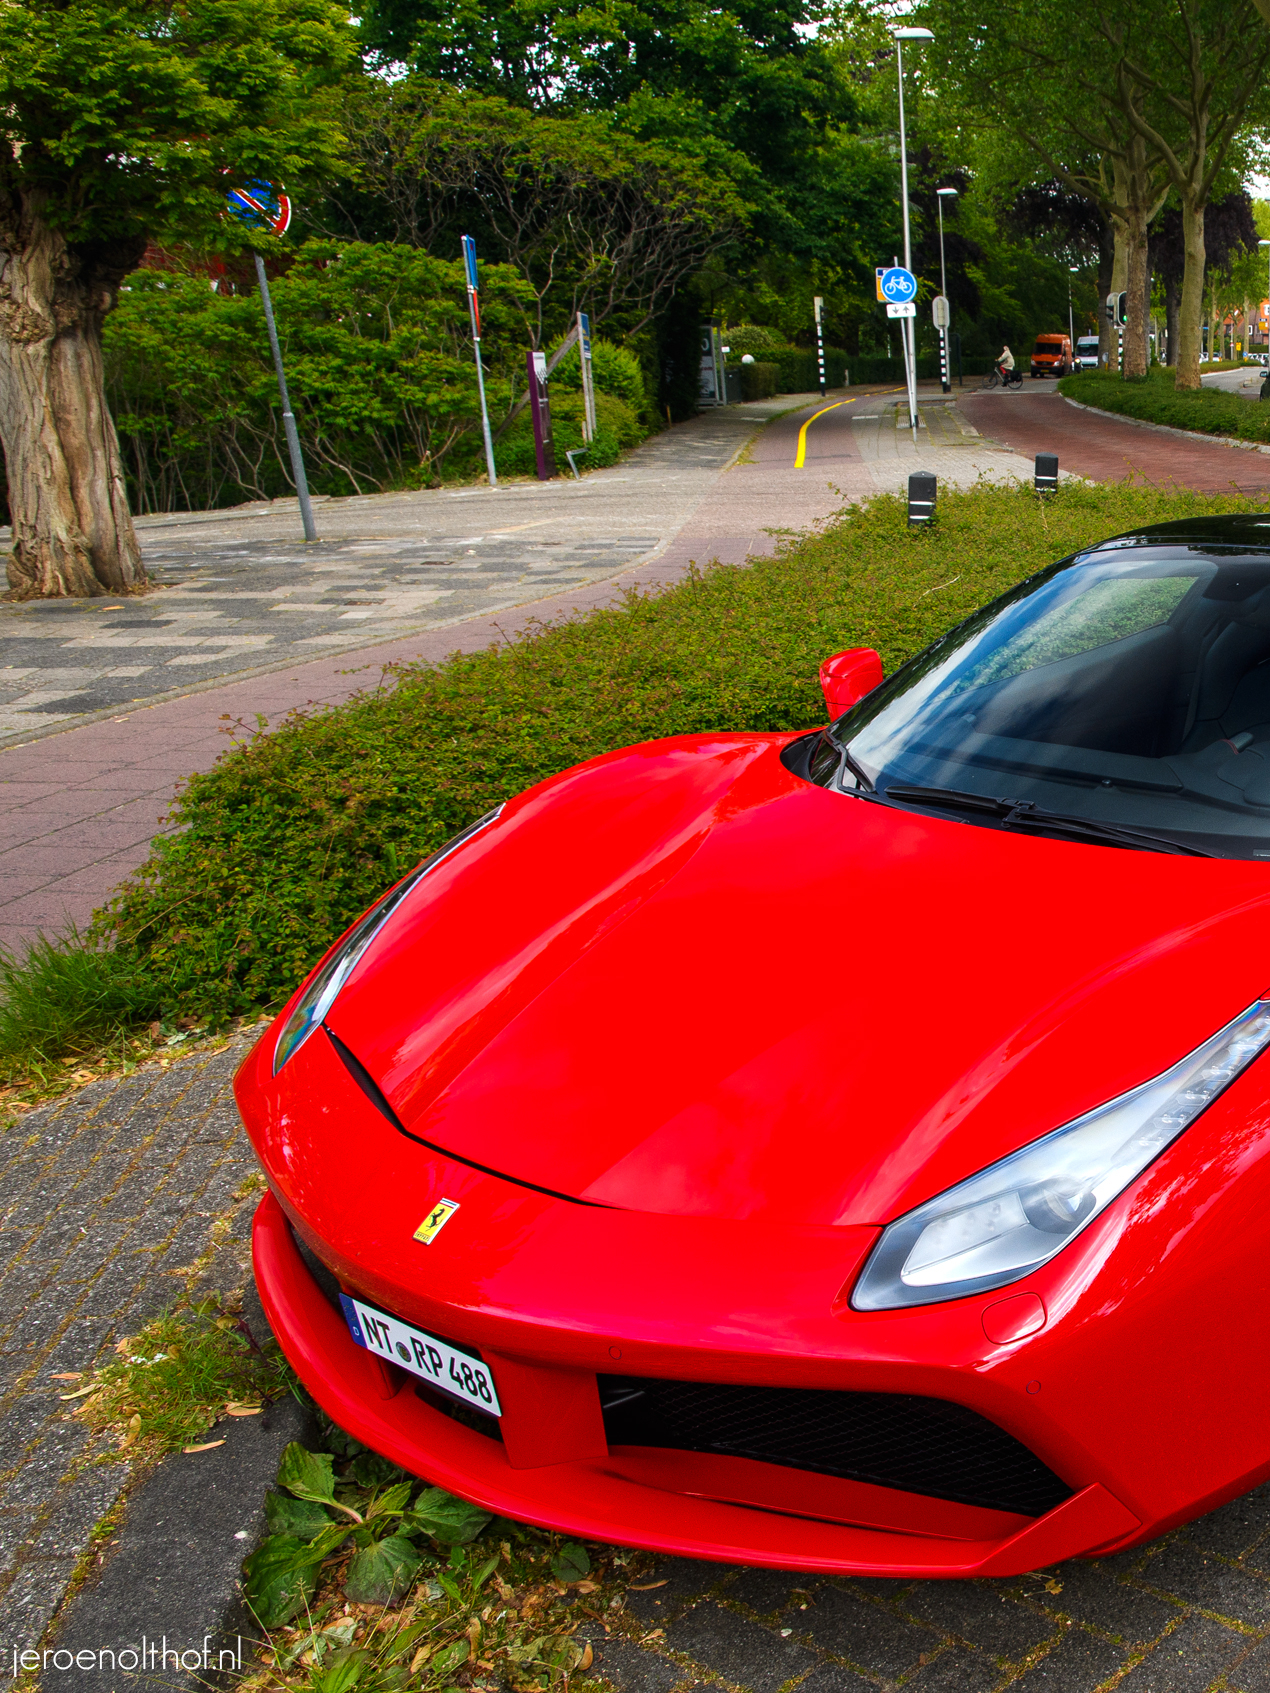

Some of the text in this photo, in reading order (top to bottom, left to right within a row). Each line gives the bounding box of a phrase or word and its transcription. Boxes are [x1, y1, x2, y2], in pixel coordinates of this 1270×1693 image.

[361, 1312, 493, 1404] NT RP 488
